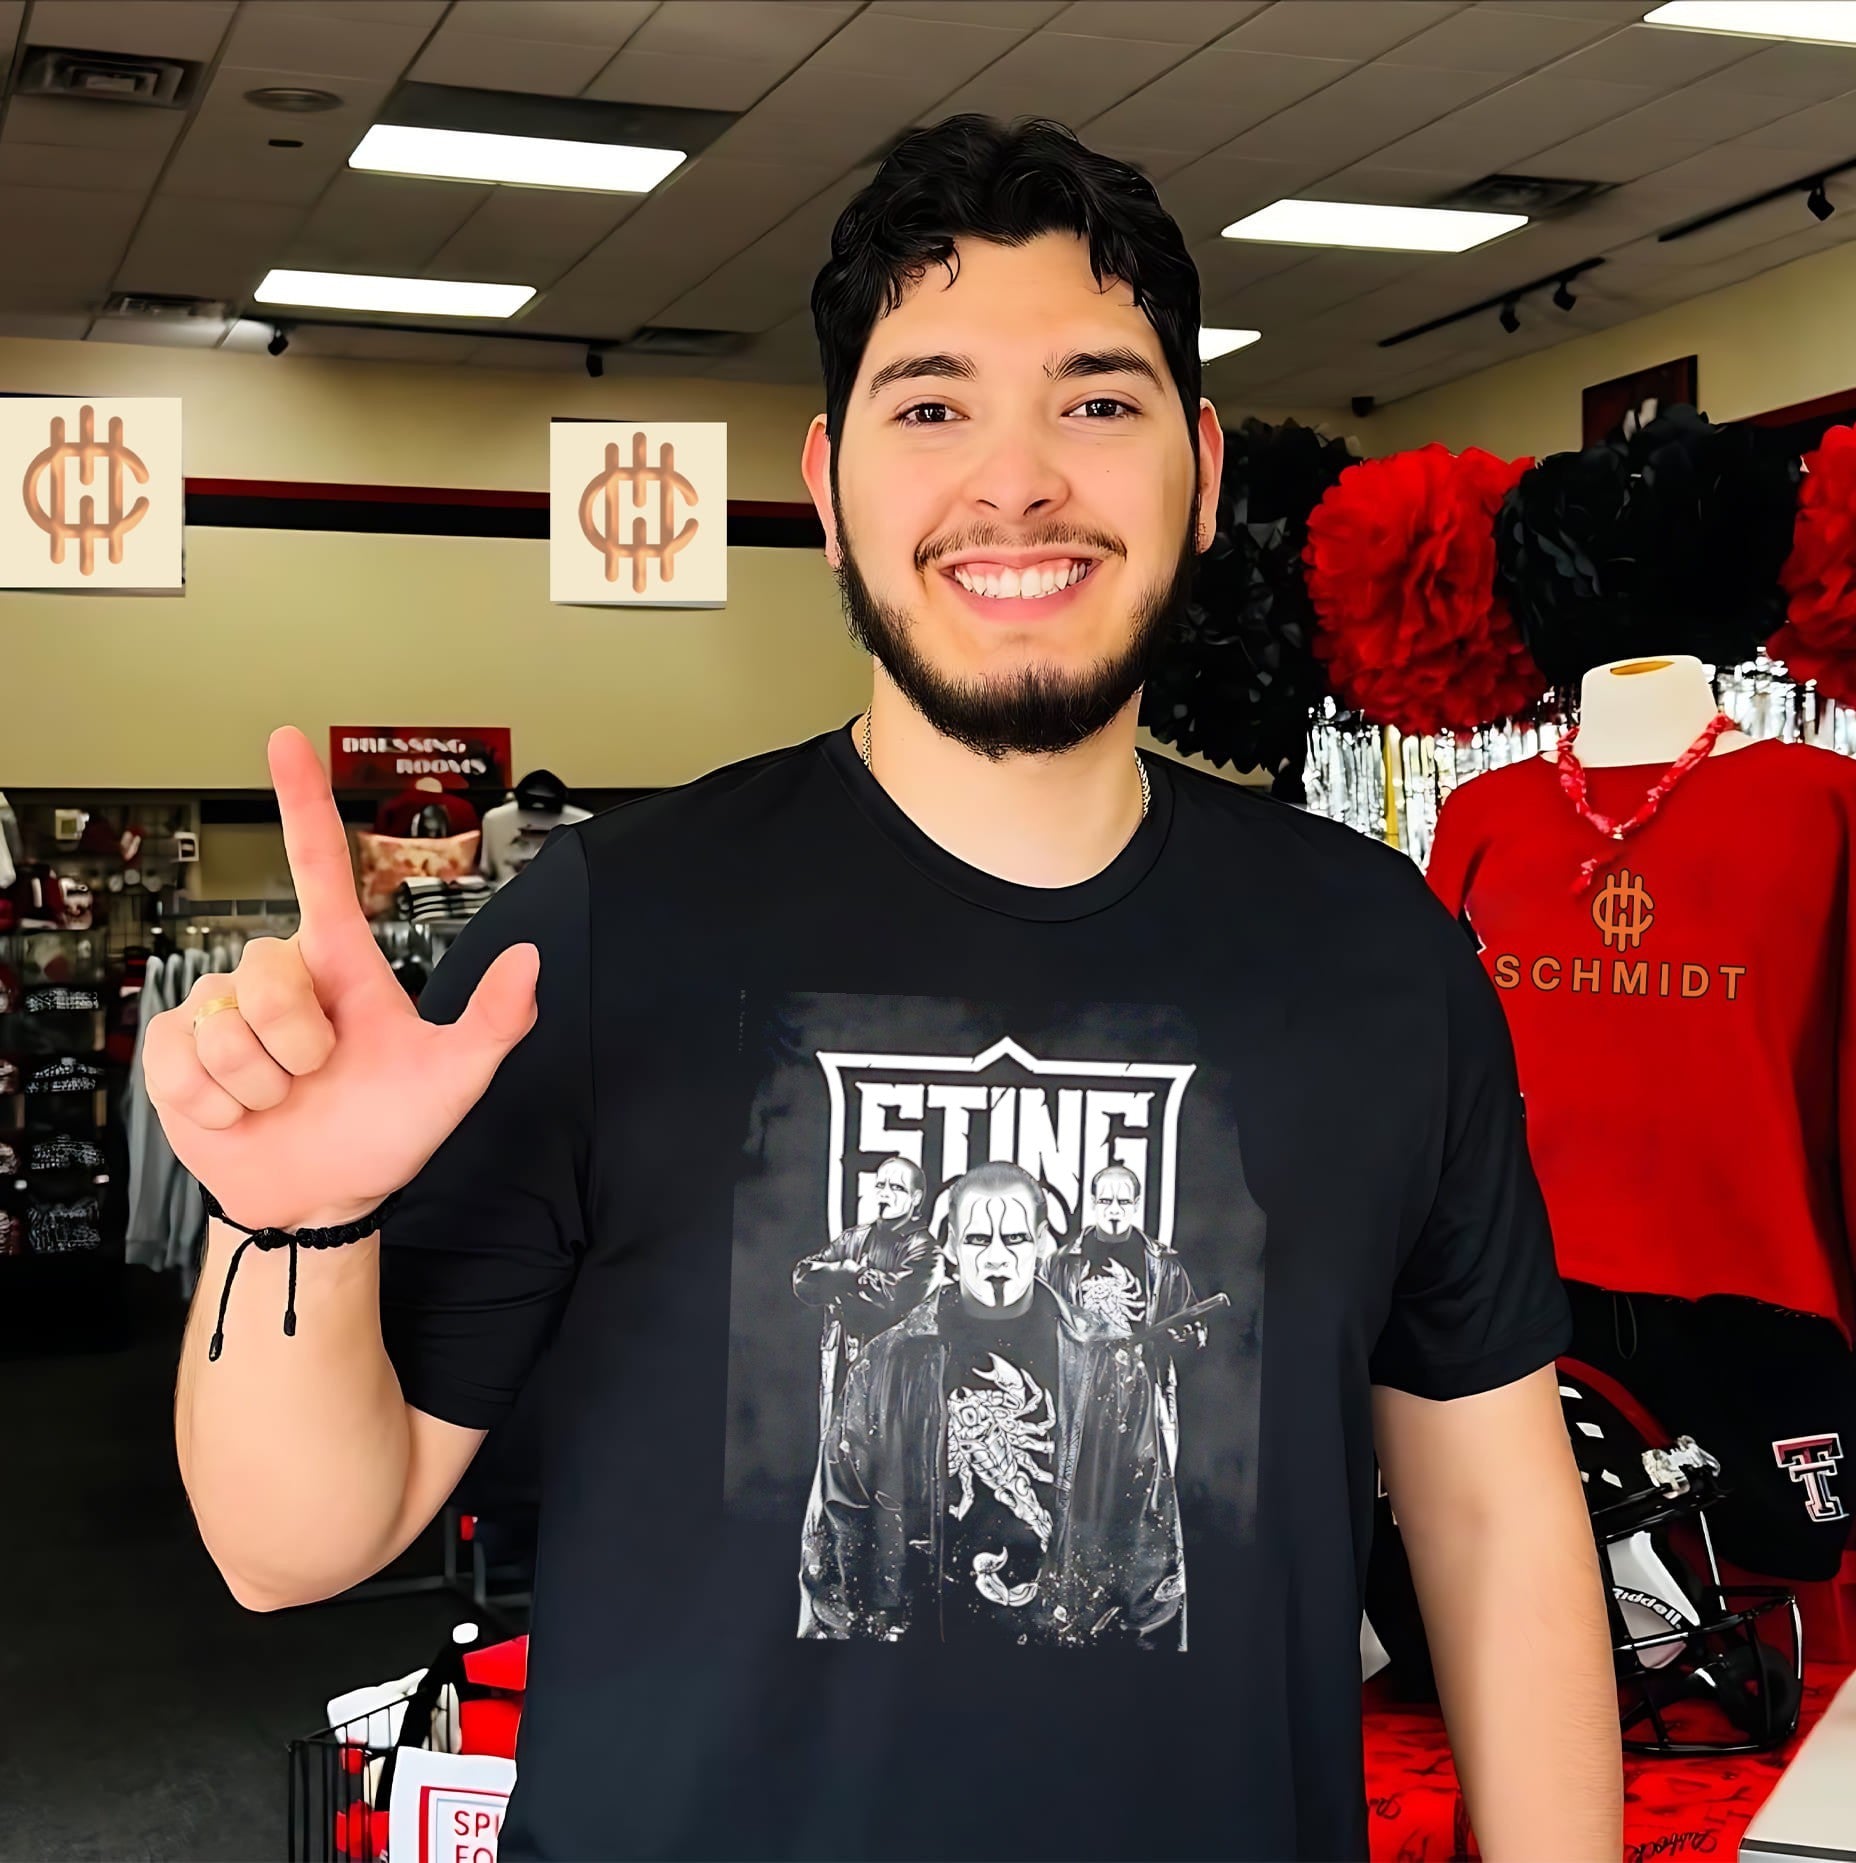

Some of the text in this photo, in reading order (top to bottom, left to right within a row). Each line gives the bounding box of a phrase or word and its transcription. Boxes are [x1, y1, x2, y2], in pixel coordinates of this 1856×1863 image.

[395, 758, 487, 775] ROOMS
[1493, 953, 1747, 1001] SCHMIDT
[855, 1081, 1156, 1230] STING
